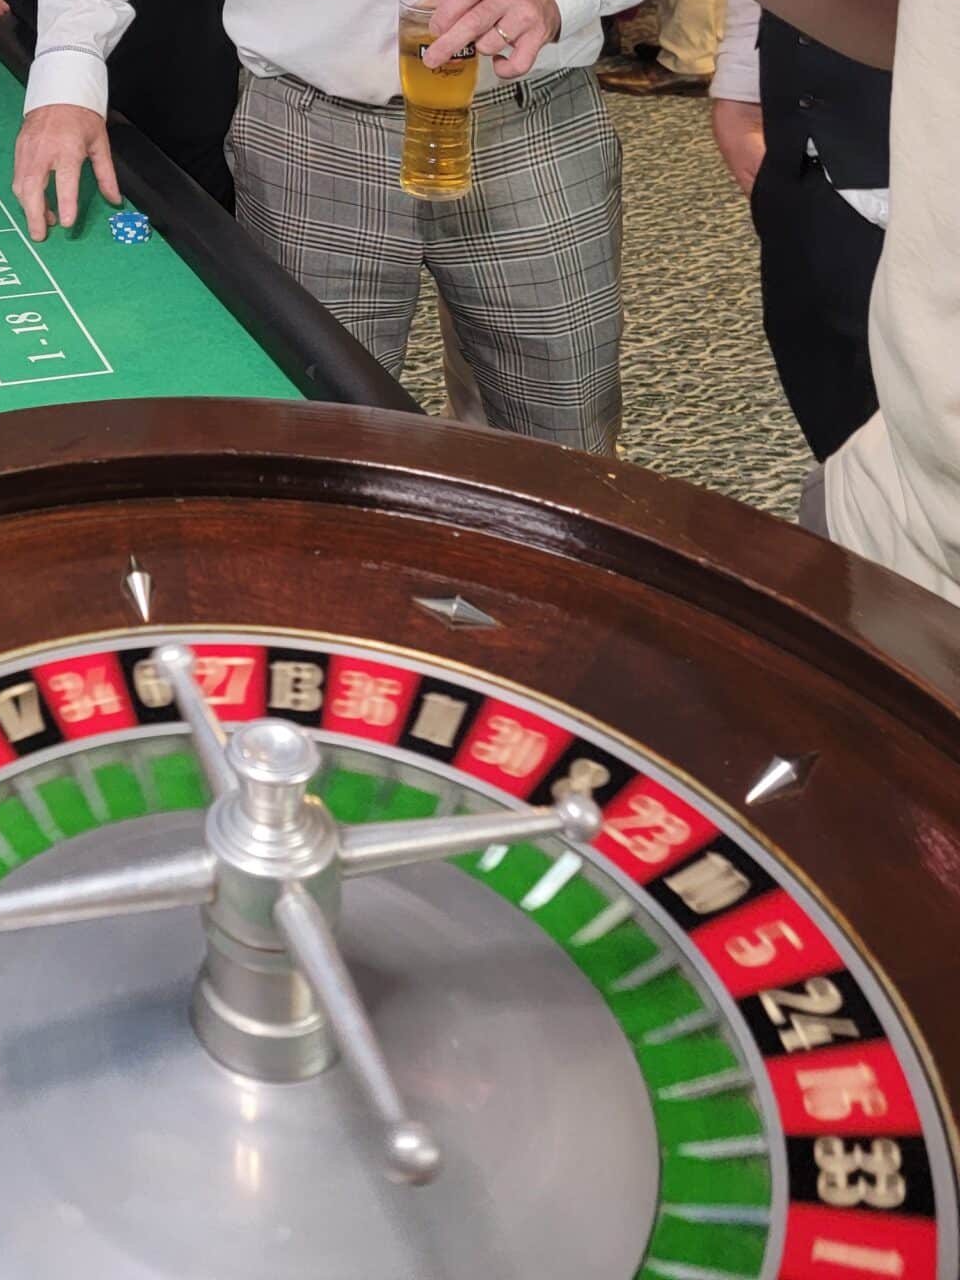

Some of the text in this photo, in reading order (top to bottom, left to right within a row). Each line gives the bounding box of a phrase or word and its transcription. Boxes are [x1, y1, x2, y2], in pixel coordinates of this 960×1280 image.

[5, 311, 49, 335] 18
[27, 350, 67, 363] 1
[601, 792, 692, 864] 23
[723, 918, 805, 969] 5
[758, 976, 861, 1053] 24
[812, 1135, 908, 1210] 33
[811, 1237, 905, 1278] 1
